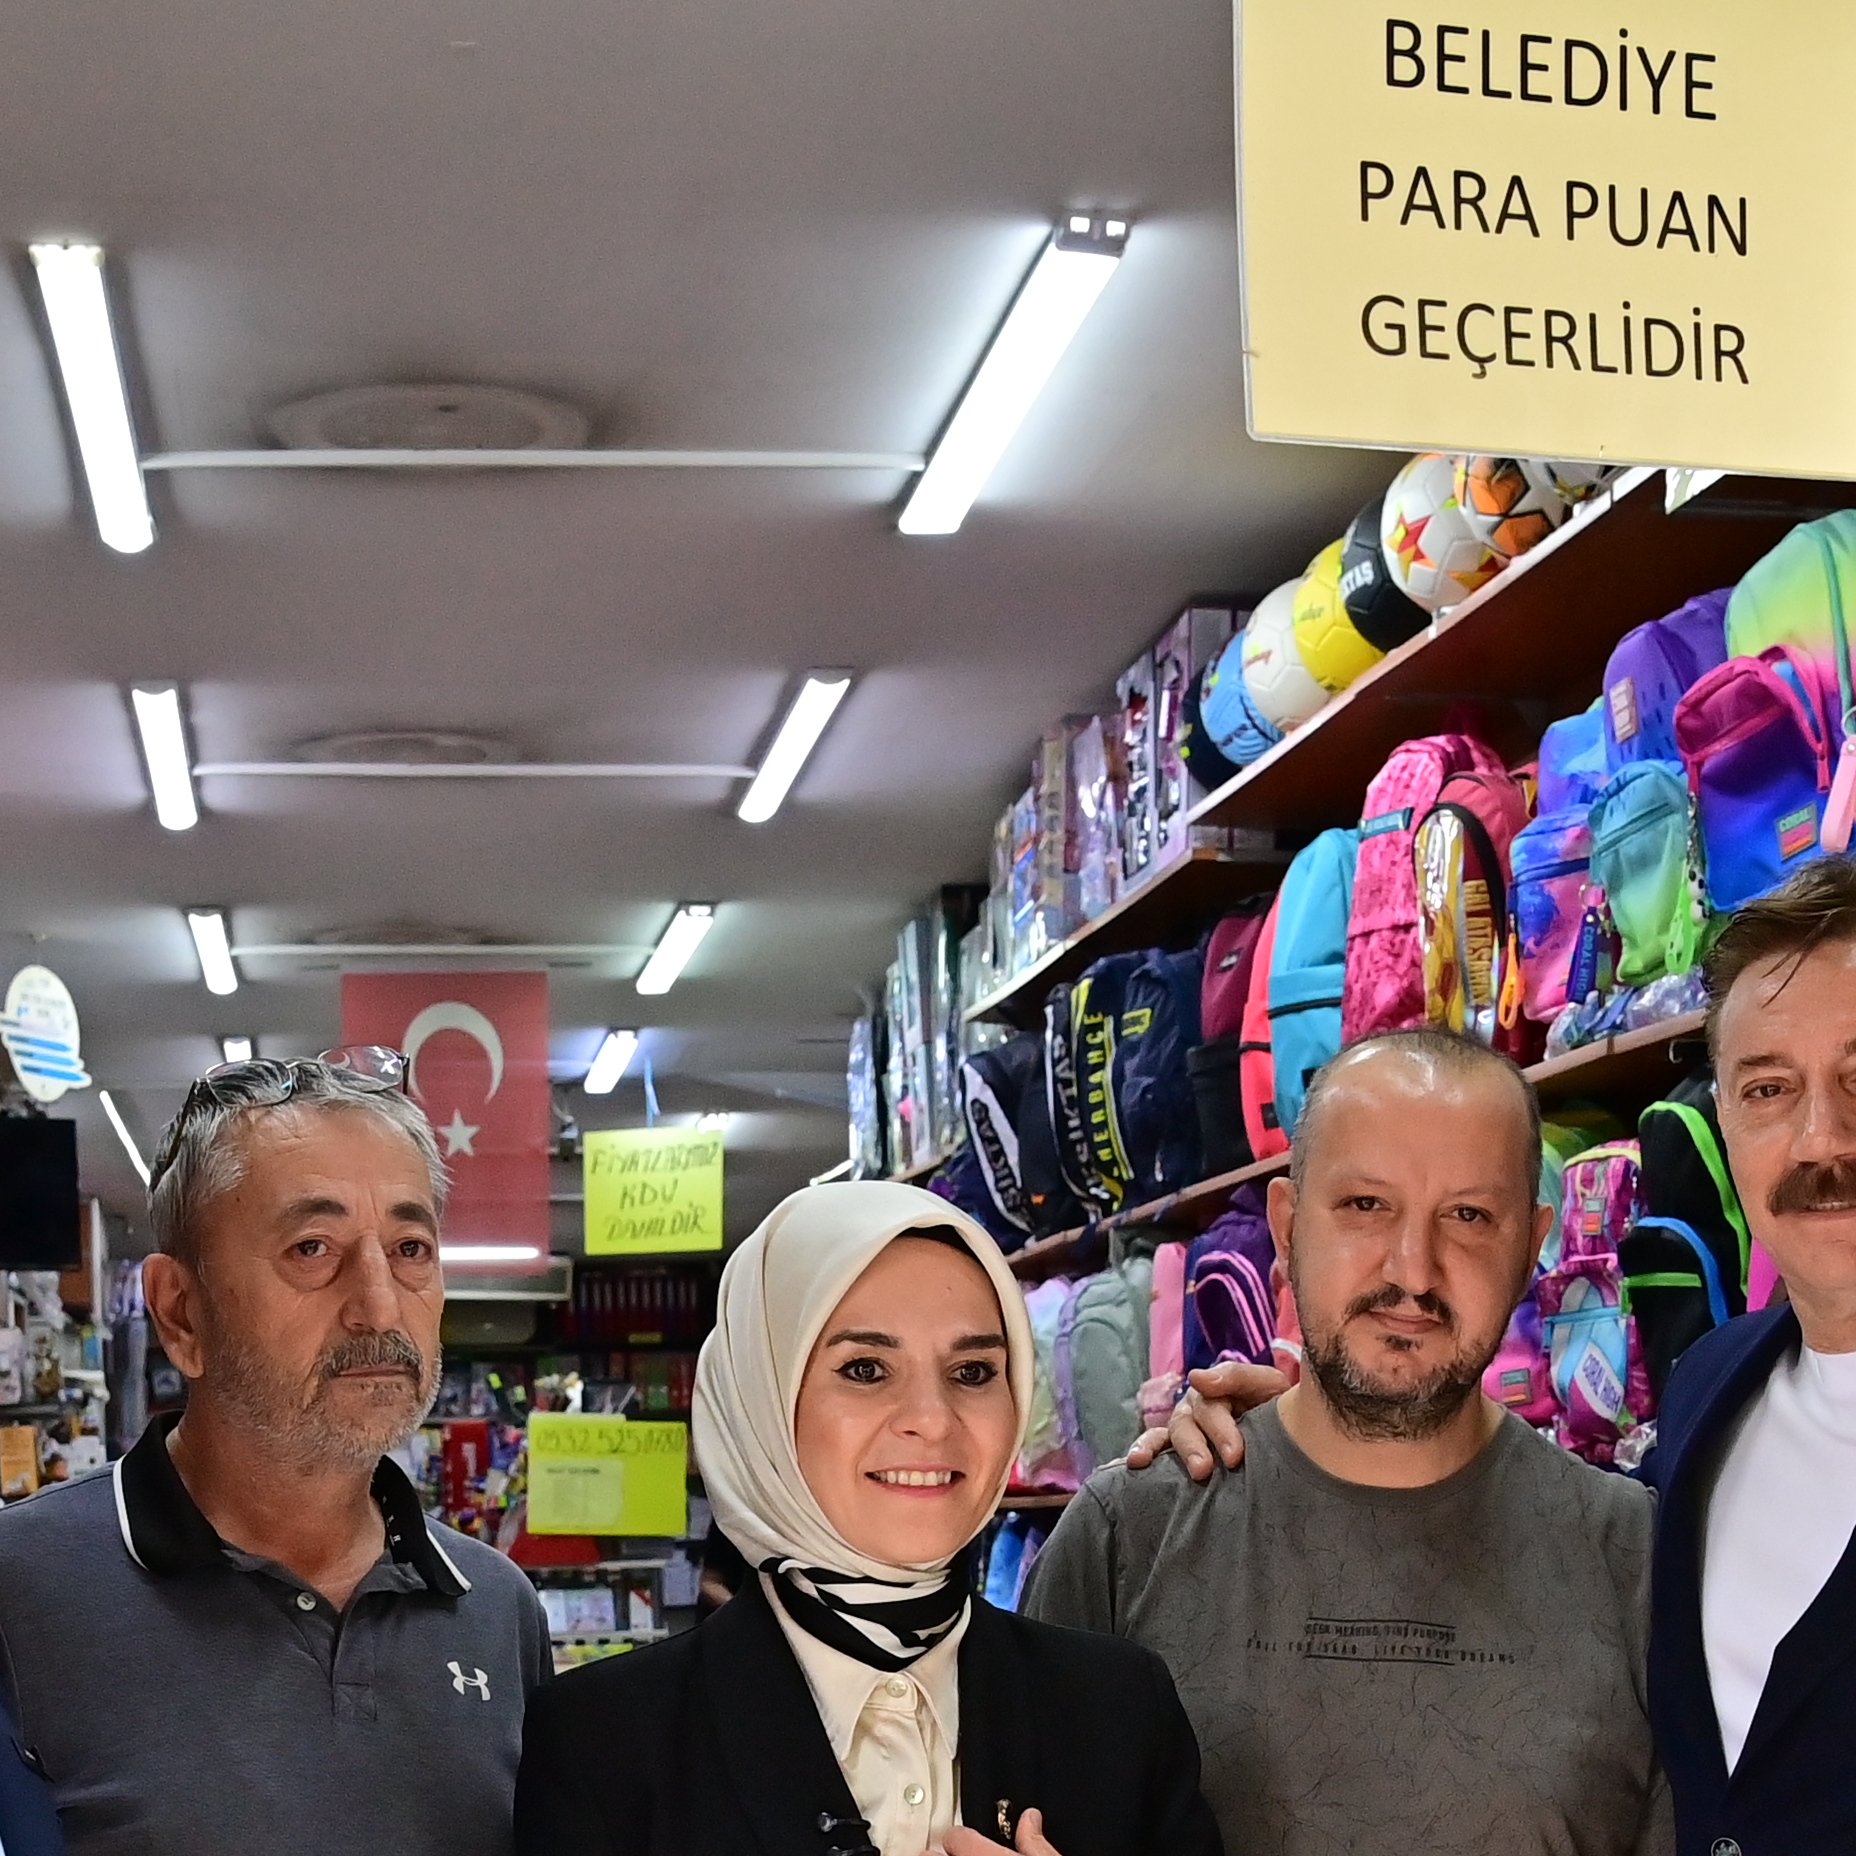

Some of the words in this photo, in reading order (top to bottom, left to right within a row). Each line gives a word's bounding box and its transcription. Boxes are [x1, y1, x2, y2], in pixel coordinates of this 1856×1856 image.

[1384, 18, 1717, 121] BELEDİYE
[1359, 160, 1541, 239] PARA
[1565, 179, 1748, 257] PUAN
[1360, 293, 1750, 385] GEÇERLİDİR
[619, 1177, 679, 1211] KDV
